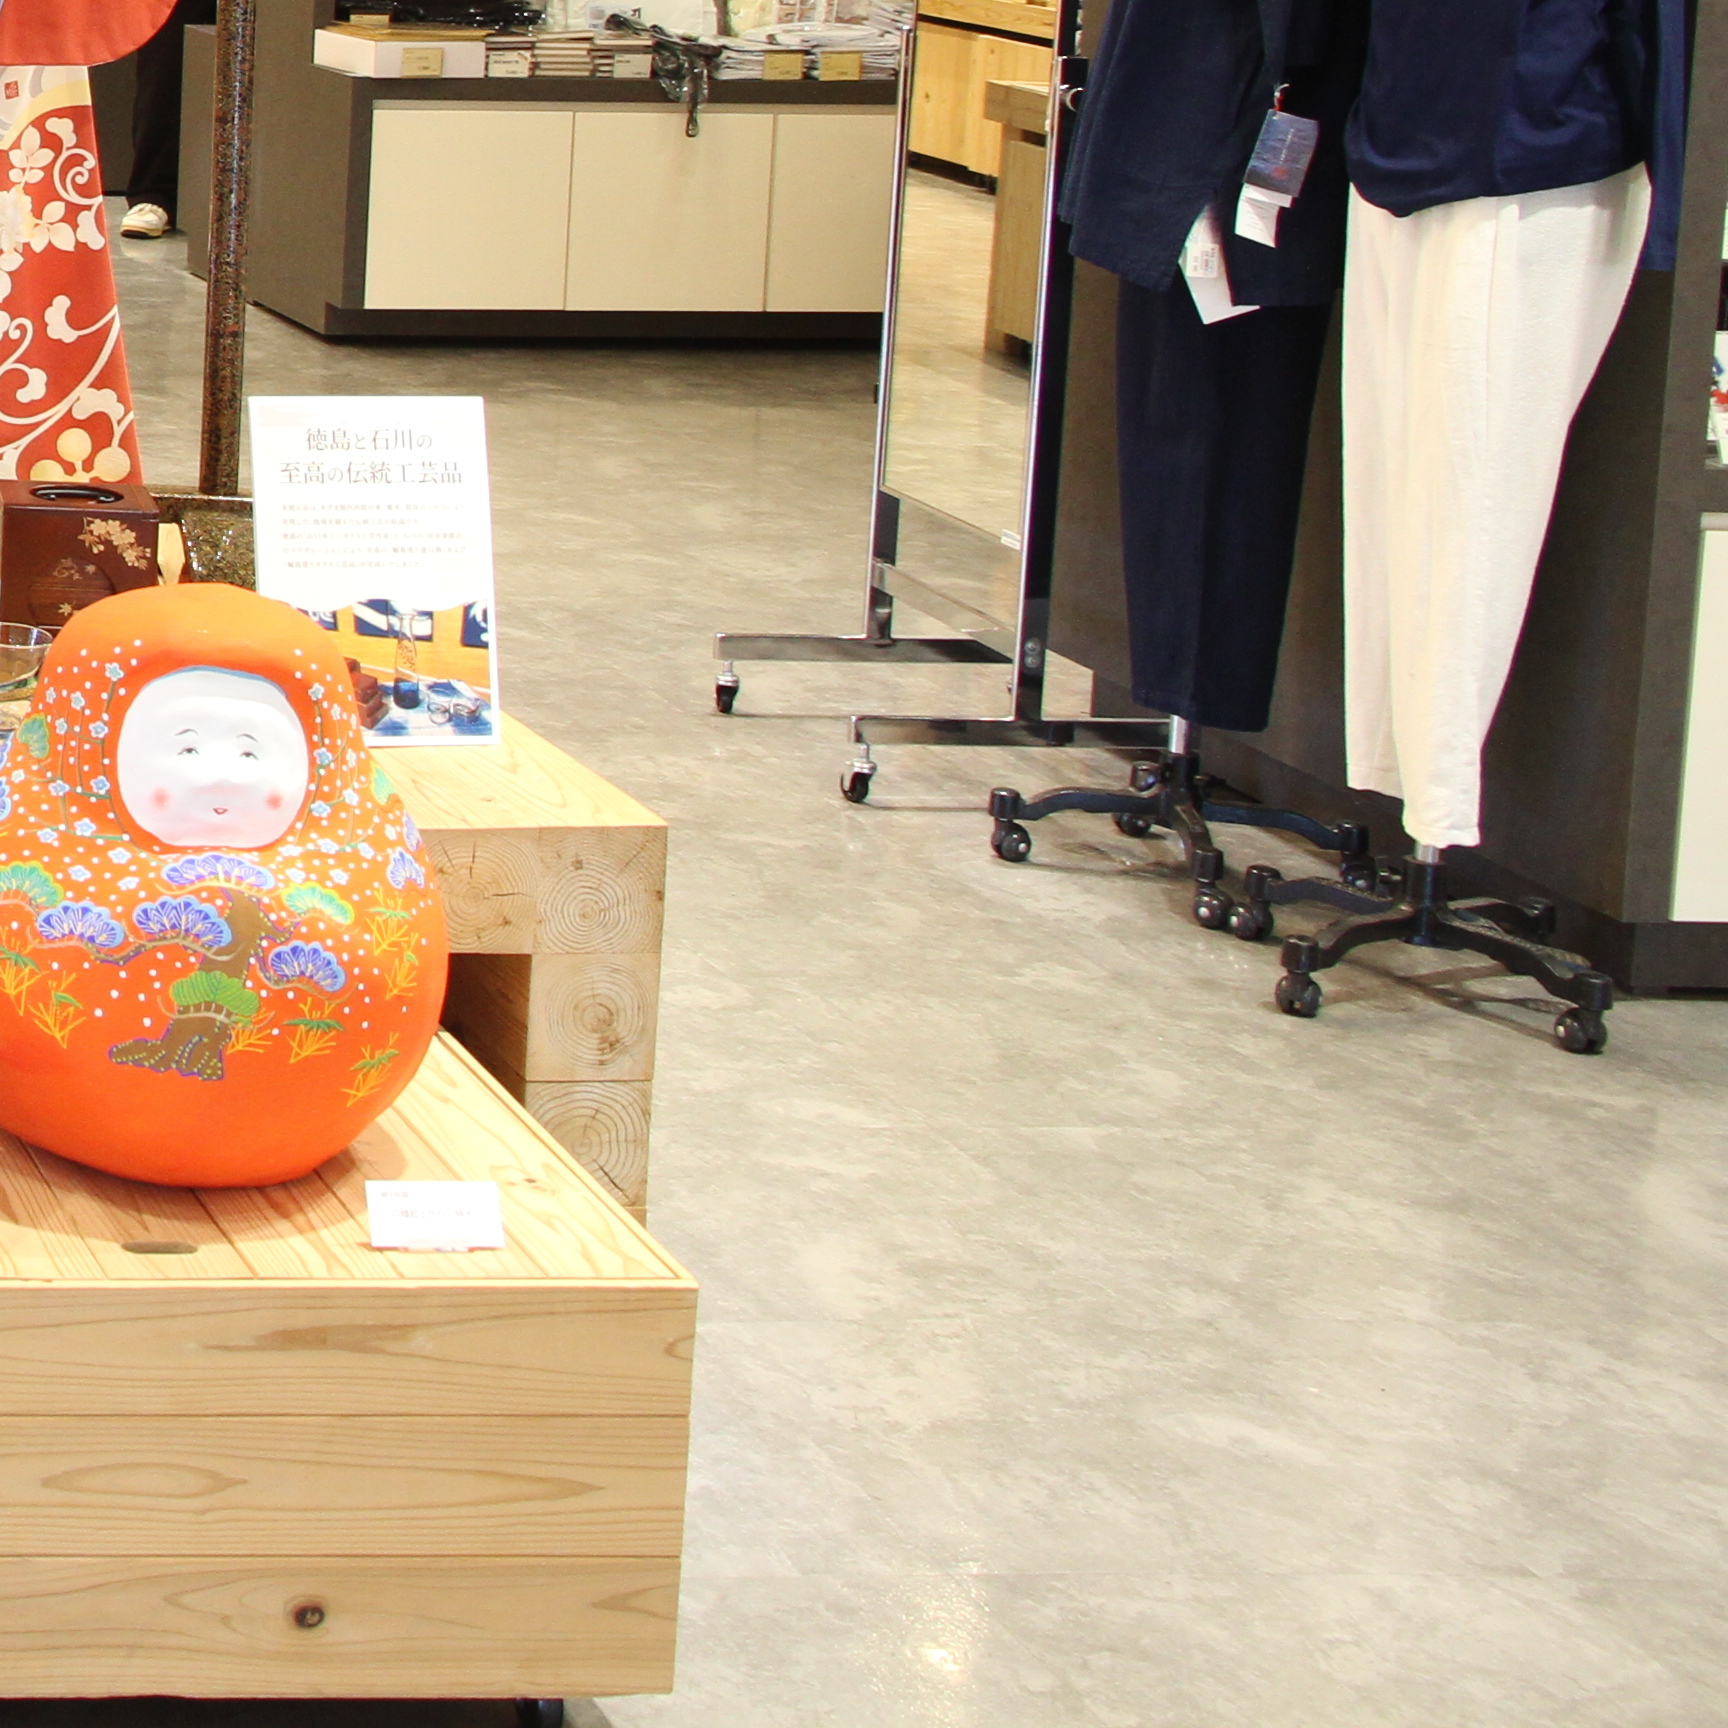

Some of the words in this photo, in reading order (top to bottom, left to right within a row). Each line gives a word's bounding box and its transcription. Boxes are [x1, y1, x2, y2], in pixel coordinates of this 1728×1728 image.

[305, 428, 433, 451] 徳島と石川の
[279, 461, 462, 484] 至高の伝統工芸品
